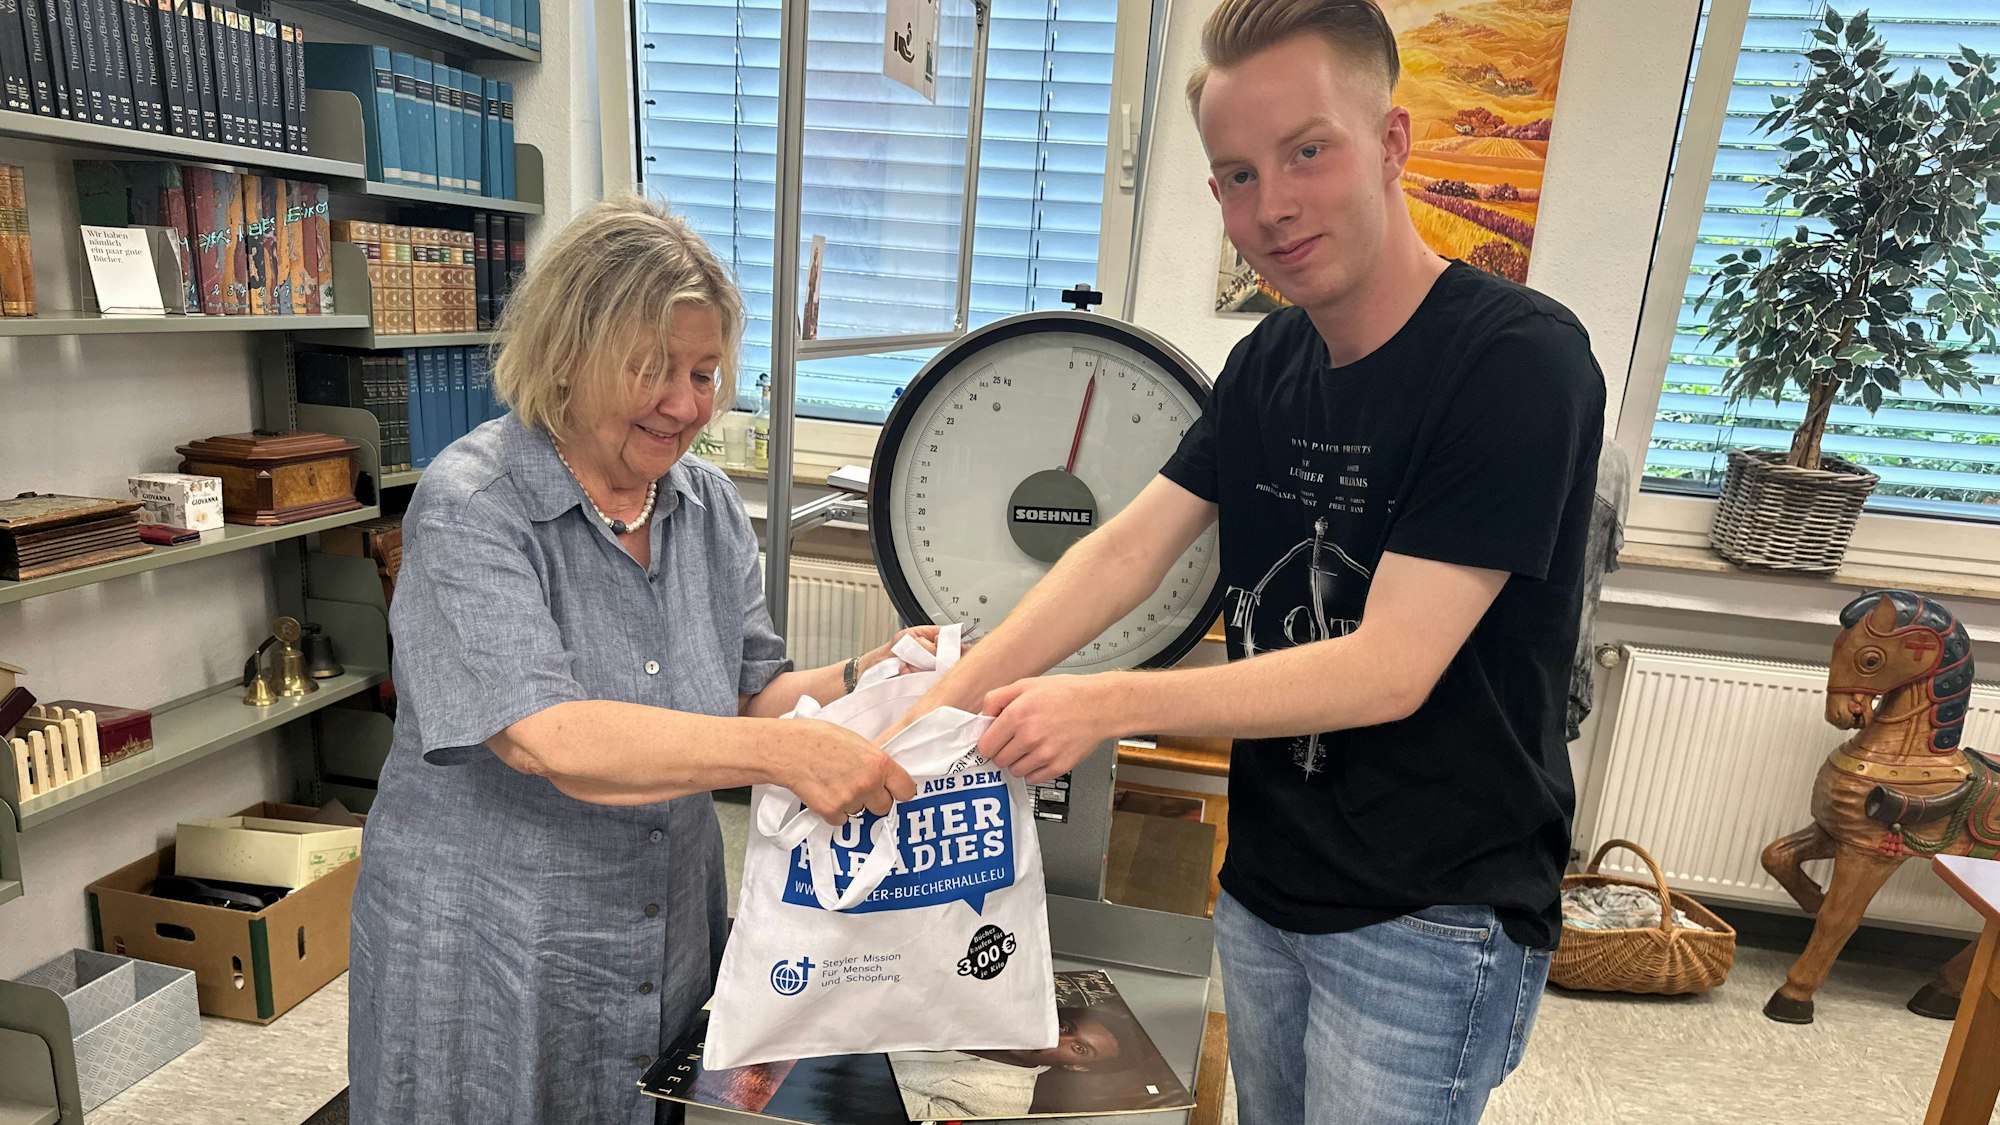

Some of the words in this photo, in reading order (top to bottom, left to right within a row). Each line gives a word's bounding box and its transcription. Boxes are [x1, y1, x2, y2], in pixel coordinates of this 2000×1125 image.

[164, 12, 178, 90] Thieme/Becker
[180, 17, 194, 94] Thieme/Becker
[197, 20, 211, 96] Thieme/Becker
[216, 24, 229, 98] Thieme/Becker
[230, 29, 242, 102] Thieme/Becker
[284, 42, 296, 112] Thieme/Becker
[296, 46, 306, 112] Thieme/Becker
[104, 231, 129, 239] haben
[93, 255, 124, 263] Bücher.
[993, 376, 1001, 384] 25
[1004, 377, 1012, 386] kg
[1131, 383, 1136, 391] 2
[142, 493, 171, 502] GIOVANNA
[192, 496, 219, 506] GIOVANNA
[1015, 509, 1090, 523] SOEHNLE
[924, 777, 955, 794] AUS
[962, 770, 1002, 786] DEM
[970, 939, 992, 954] kaufen
[993, 932, 1004, 941] für
[974, 928, 996, 943] Bücher
[822, 957, 858, 969] Steyler
[863, 953, 901, 963] Mission
[959, 945, 1000, 974] 3,00
[1001, 935, 1015, 954] €
[822, 969, 838, 978] Für
[843, 964, 882, 973] Mensch
[990, 962, 1004, 972] Kilo
[822, 978, 840, 987] und
[846, 974, 900, 983] Schöpfung
[659, 1042, 705, 1094] UNSET
